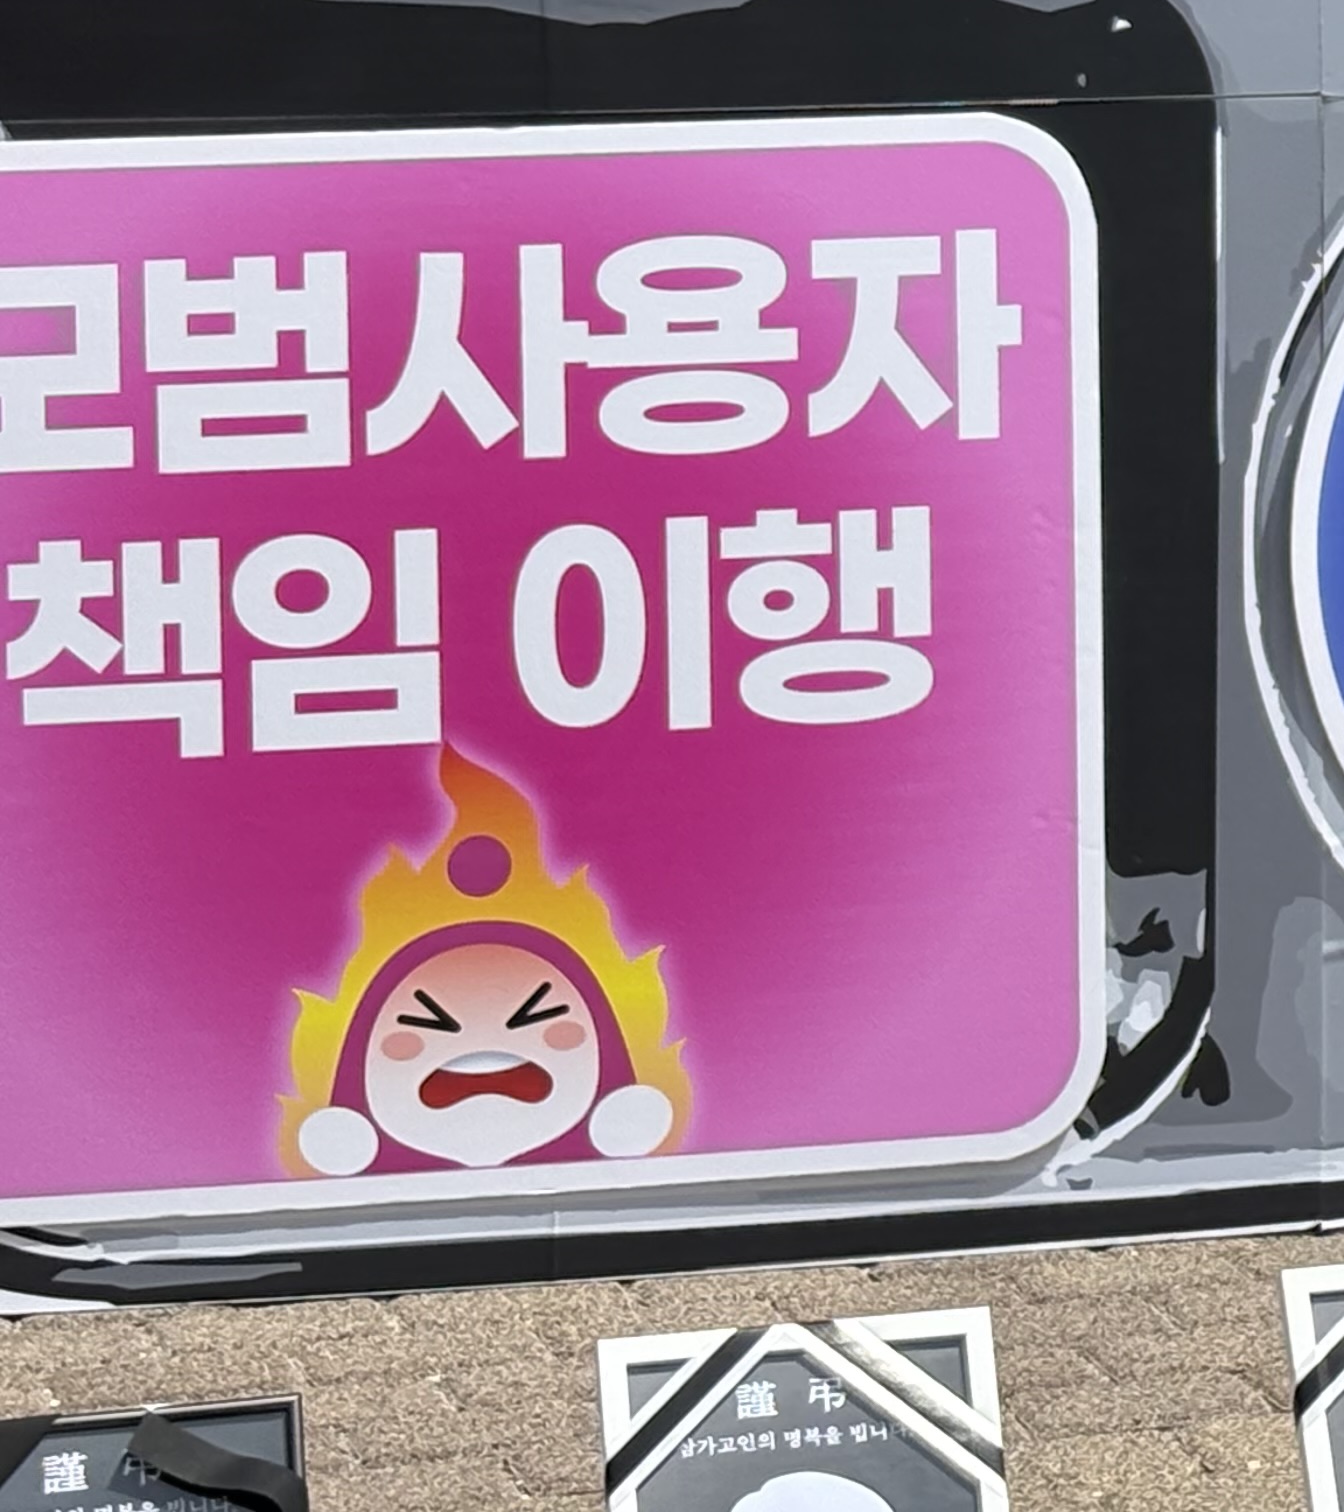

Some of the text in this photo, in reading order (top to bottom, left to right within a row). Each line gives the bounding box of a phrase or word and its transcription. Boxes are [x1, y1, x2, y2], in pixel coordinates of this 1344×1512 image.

[0, 228, 1021, 473] 모범사용자
[7, 506, 934, 758] 책임 이행
